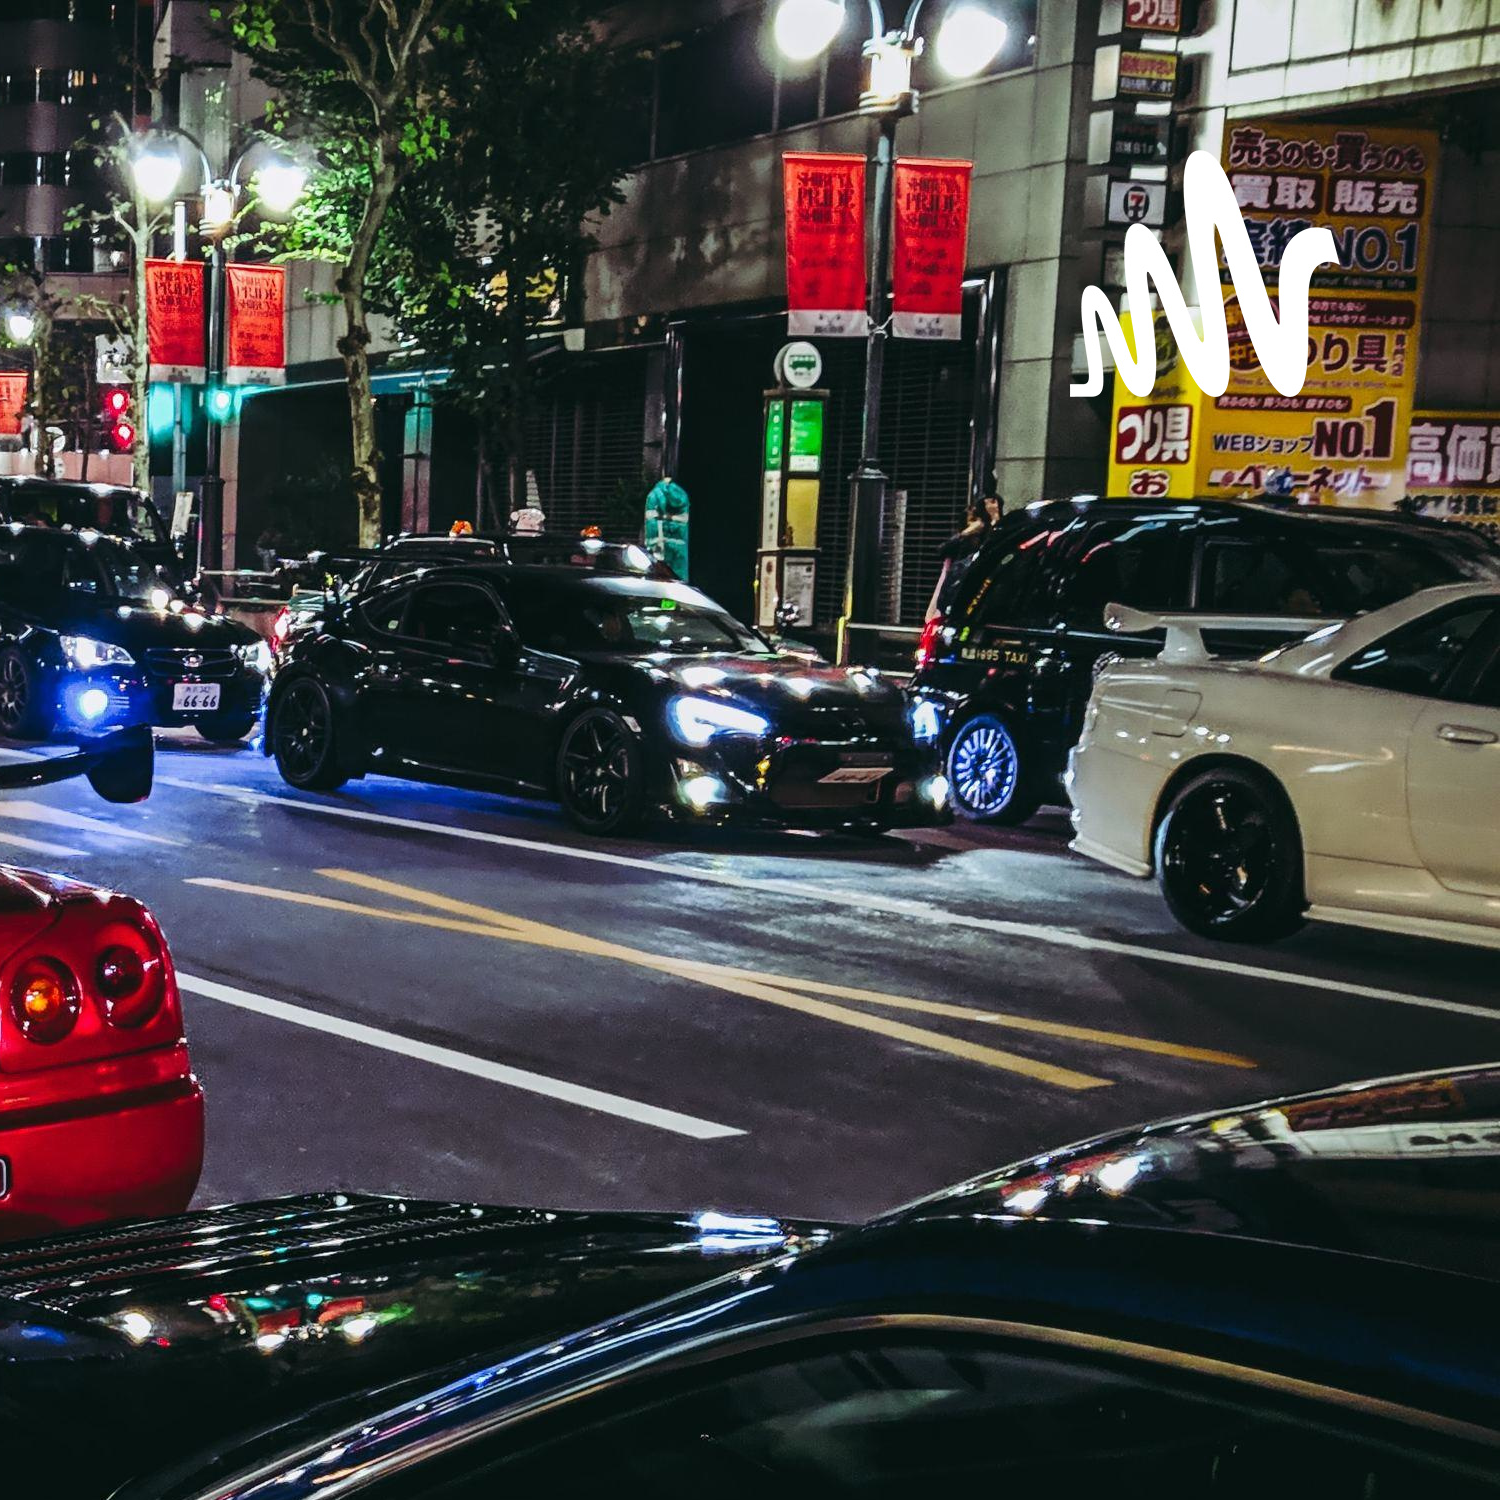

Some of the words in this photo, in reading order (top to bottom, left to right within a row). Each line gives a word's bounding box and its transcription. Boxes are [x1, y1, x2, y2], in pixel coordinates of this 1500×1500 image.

[1231, 174, 1316, 209] 買取
[1332, 179, 1418, 214] 販売
[1118, 406, 1190, 462] つり具
[1213, 434, 1313, 454] WEBショップ
[1312, 398, 1396, 459] NO.1
[1408, 424, 1500, 484] 高価
[1130, 470, 1170, 497] お
[1004, 651, 1028, 663] TAXI
[183, 696, 217, 708] 66-66
